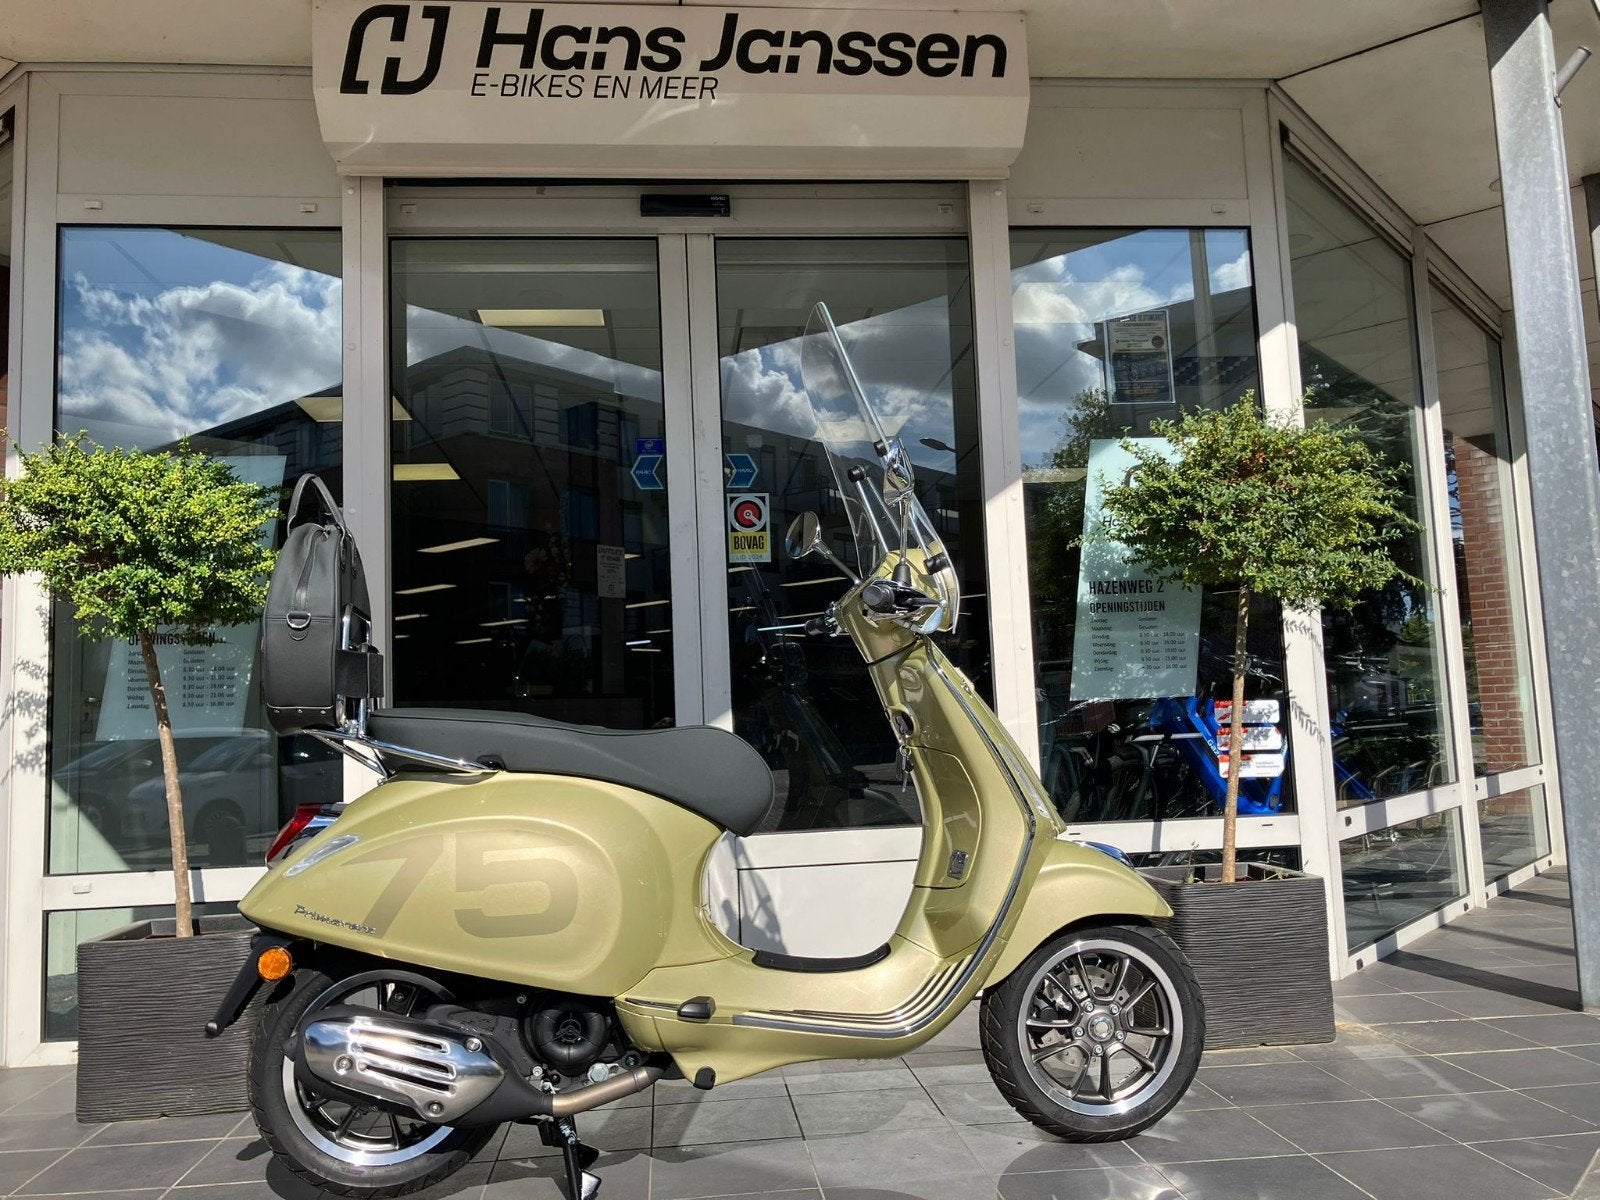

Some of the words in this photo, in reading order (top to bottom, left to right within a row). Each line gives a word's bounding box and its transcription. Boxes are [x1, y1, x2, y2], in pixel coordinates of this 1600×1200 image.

[476, 8, 685, 73] Hans
[699, 13, 1007, 78] Janssen
[471, 73, 585, 98] E-BIKES
[594, 75, 631, 99] EN
[639, 76, 719, 100] MEER
[734, 535, 764, 550] BOVAG
[1089, 579, 1153, 595] HAZENWEG
[1157, 580, 1164, 593] 2
[1089, 600, 1166, 613] OPENINGSTIJDEN
[339, 830, 579, 938] 75
[294, 904, 376, 935] Primavera
